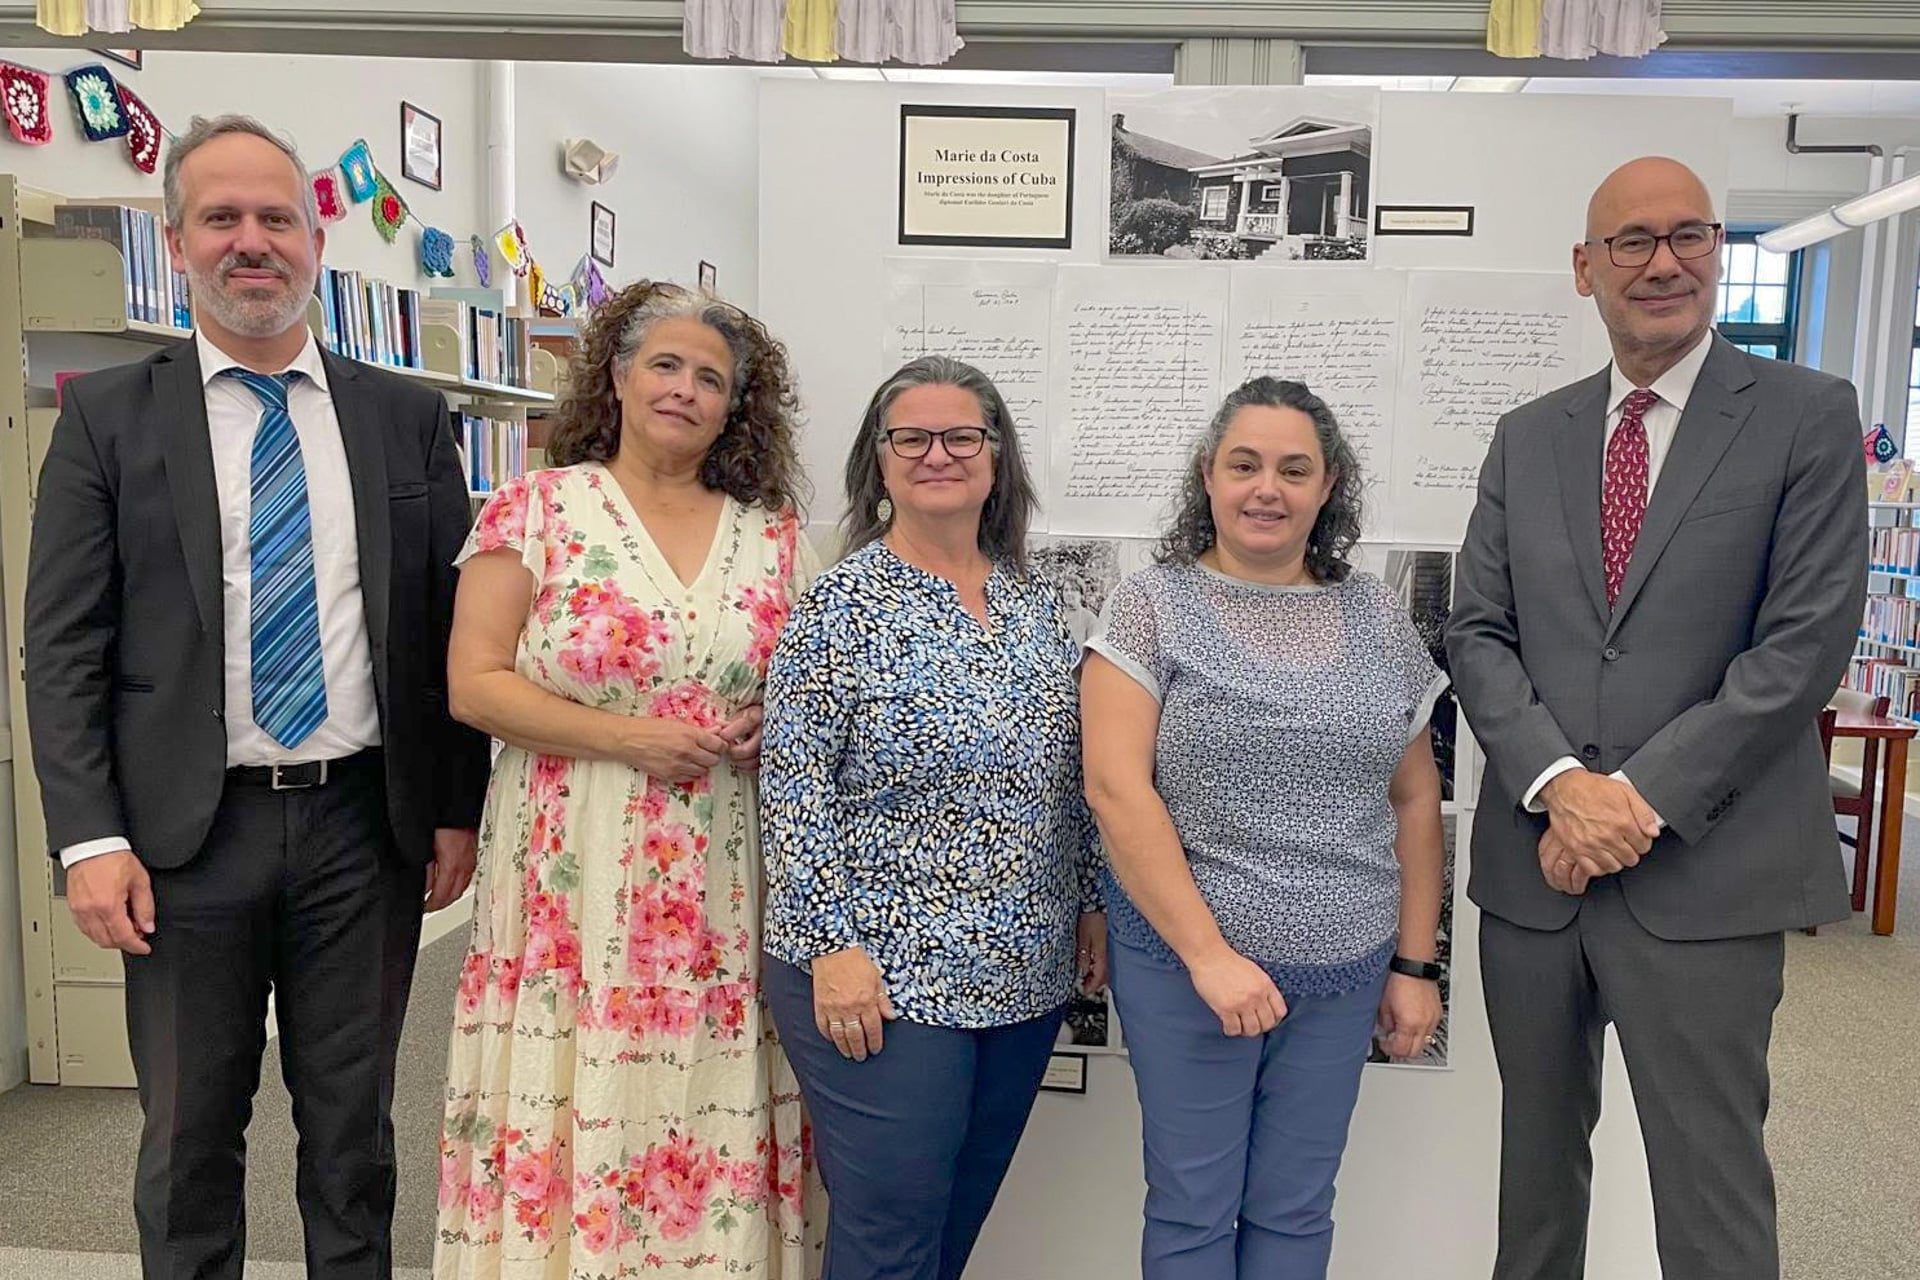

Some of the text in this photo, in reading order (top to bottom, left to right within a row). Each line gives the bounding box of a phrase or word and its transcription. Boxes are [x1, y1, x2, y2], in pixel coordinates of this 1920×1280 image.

[935, 149, 1039, 163] Marie da Costa
[917, 171, 1057, 187] Impressions of Cuba
